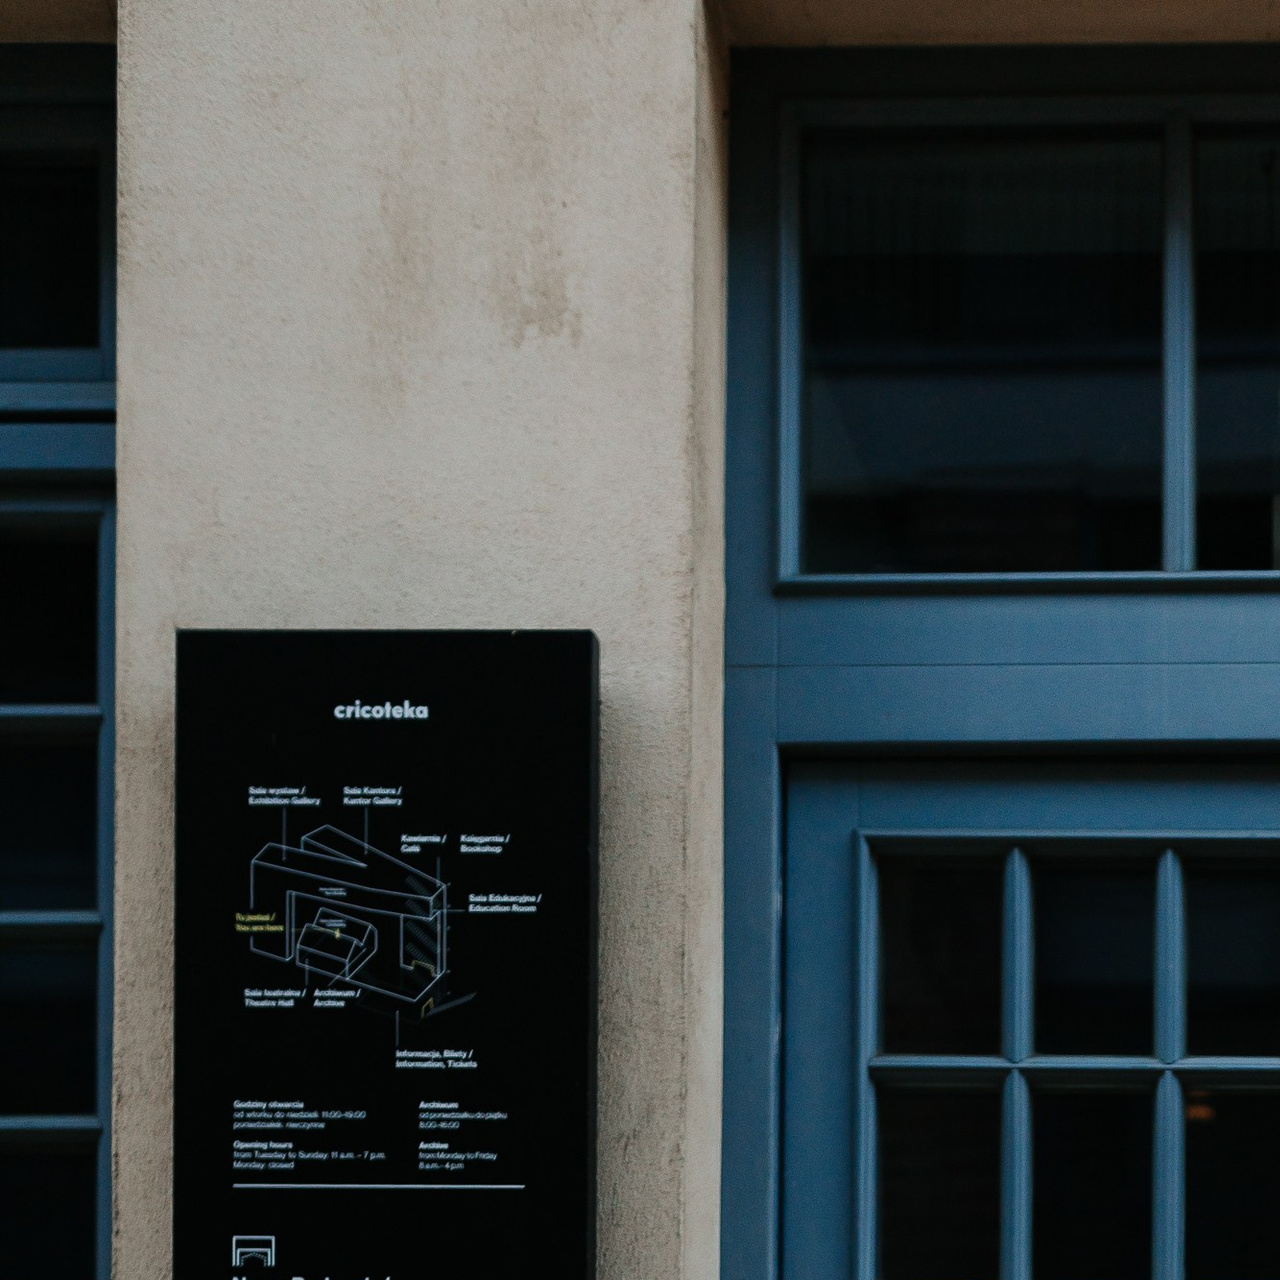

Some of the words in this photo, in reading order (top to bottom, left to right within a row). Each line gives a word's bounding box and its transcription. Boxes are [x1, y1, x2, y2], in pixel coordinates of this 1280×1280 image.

[334, 700, 428, 719] cricoteka
[290, 797, 320, 805] Gallery
[372, 797, 402, 805] Gallery
[511, 904, 537, 912] Room
[447, 1060, 477, 1068] Tickets
